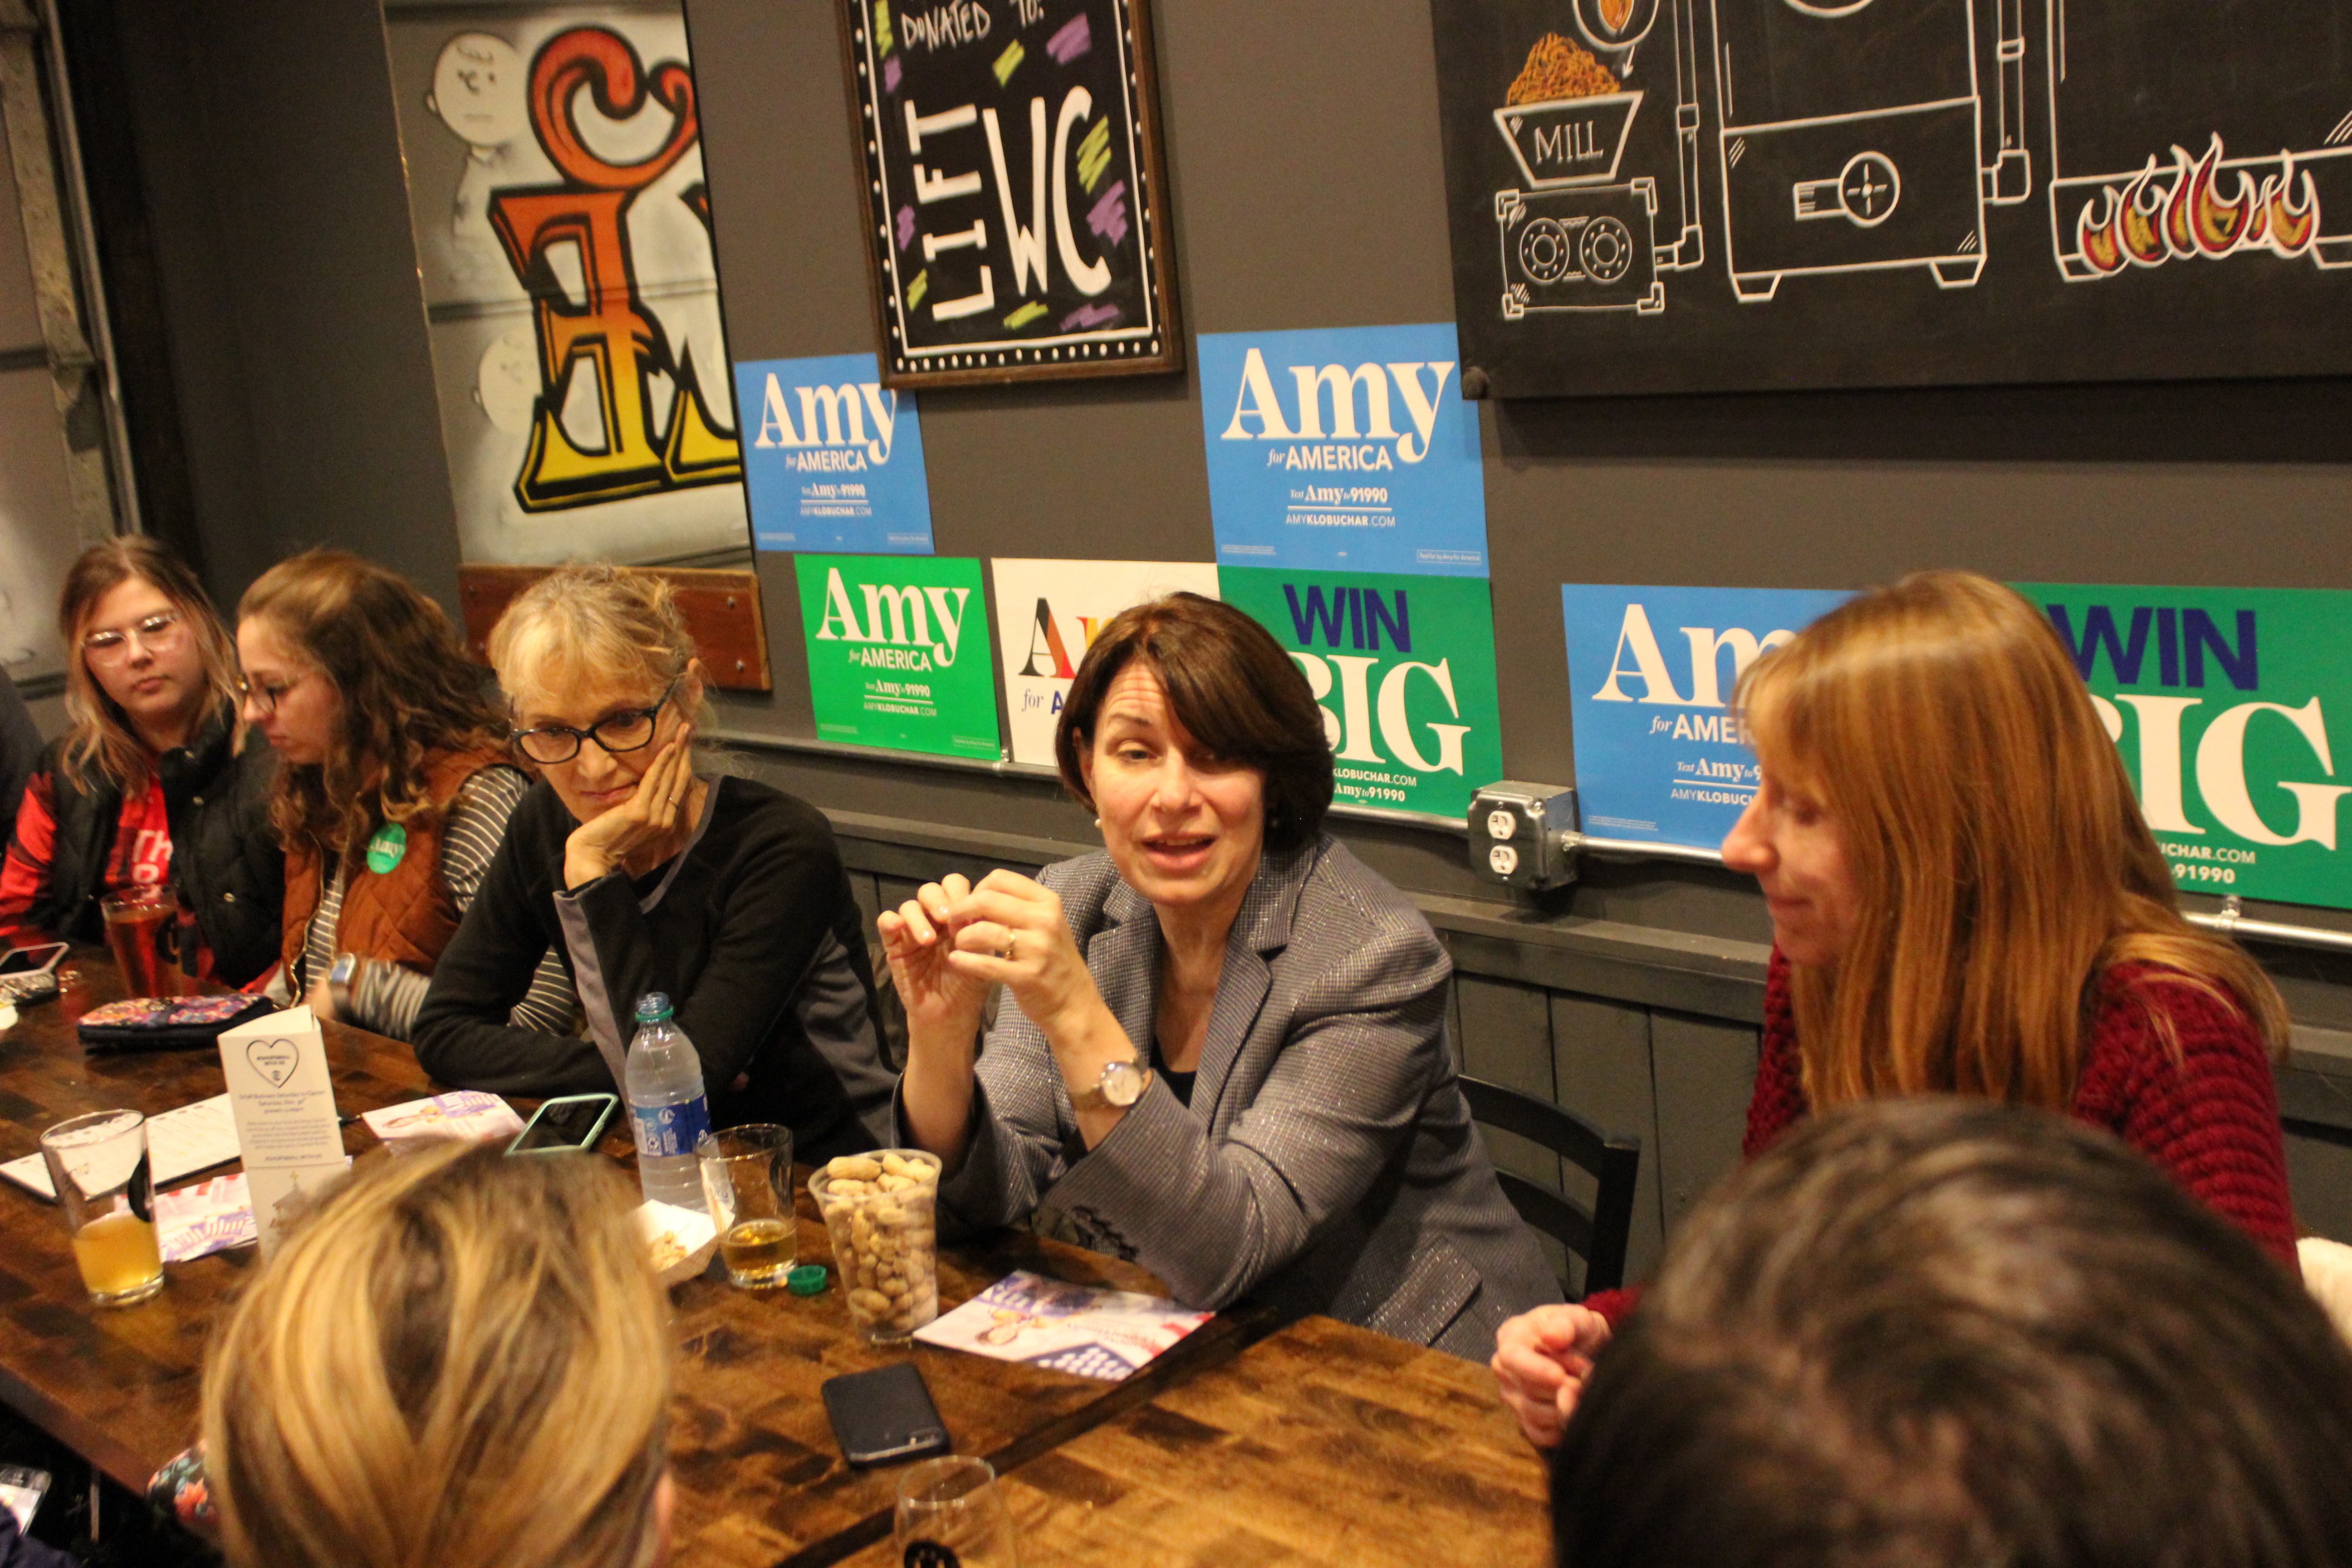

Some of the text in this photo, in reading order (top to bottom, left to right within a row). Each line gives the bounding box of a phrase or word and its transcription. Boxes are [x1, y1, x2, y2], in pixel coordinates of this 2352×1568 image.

[902, 0, 991, 53] DONATED
[1534, 121, 1603, 164] MILL
[982, 86, 1112, 297] WC
[905, 99, 995, 321] LIFT
[1221, 348, 1455, 463] Amy
[754, 373, 897, 465] Amy
[797, 450, 867, 471] AMERICA
[1268, 445, 1393, 470] for AMERICA
[811, 482, 837, 499] Amy
[1290, 489, 1304, 498] Text
[1305, 485, 1344, 505] Amy
[1351, 487, 1388, 503] 91990
[1286, 514, 1395, 526] AMYKLOBUCHAR.COM
[816, 568, 970, 667] Amy
[1283, 584, 1411, 652] WIN
[861, 647, 932, 671] AMERICA
[1592, 604, 1799, 708] Am
[2046, 604, 2258, 690] WIN
[875, 679, 901, 697] Amy
[905, 683, 931, 697] 91990
[1021, 689, 1043, 711] for
[1649, 714, 1756, 745] for AMER
[1333, 768, 1416, 786] KLOBUCHAR.COM
[1677, 762, 1695, 771] Text
[1695, 758, 1745, 782] Amy
[1744, 769, 1753, 778] to
[2089, 694, 2352, 851] IG
[1334, 782, 1405, 802] Amy to 91990
[1671, 789, 1754, 805] AMYKLOBUC
[2174, 863, 2236, 884] 91990
